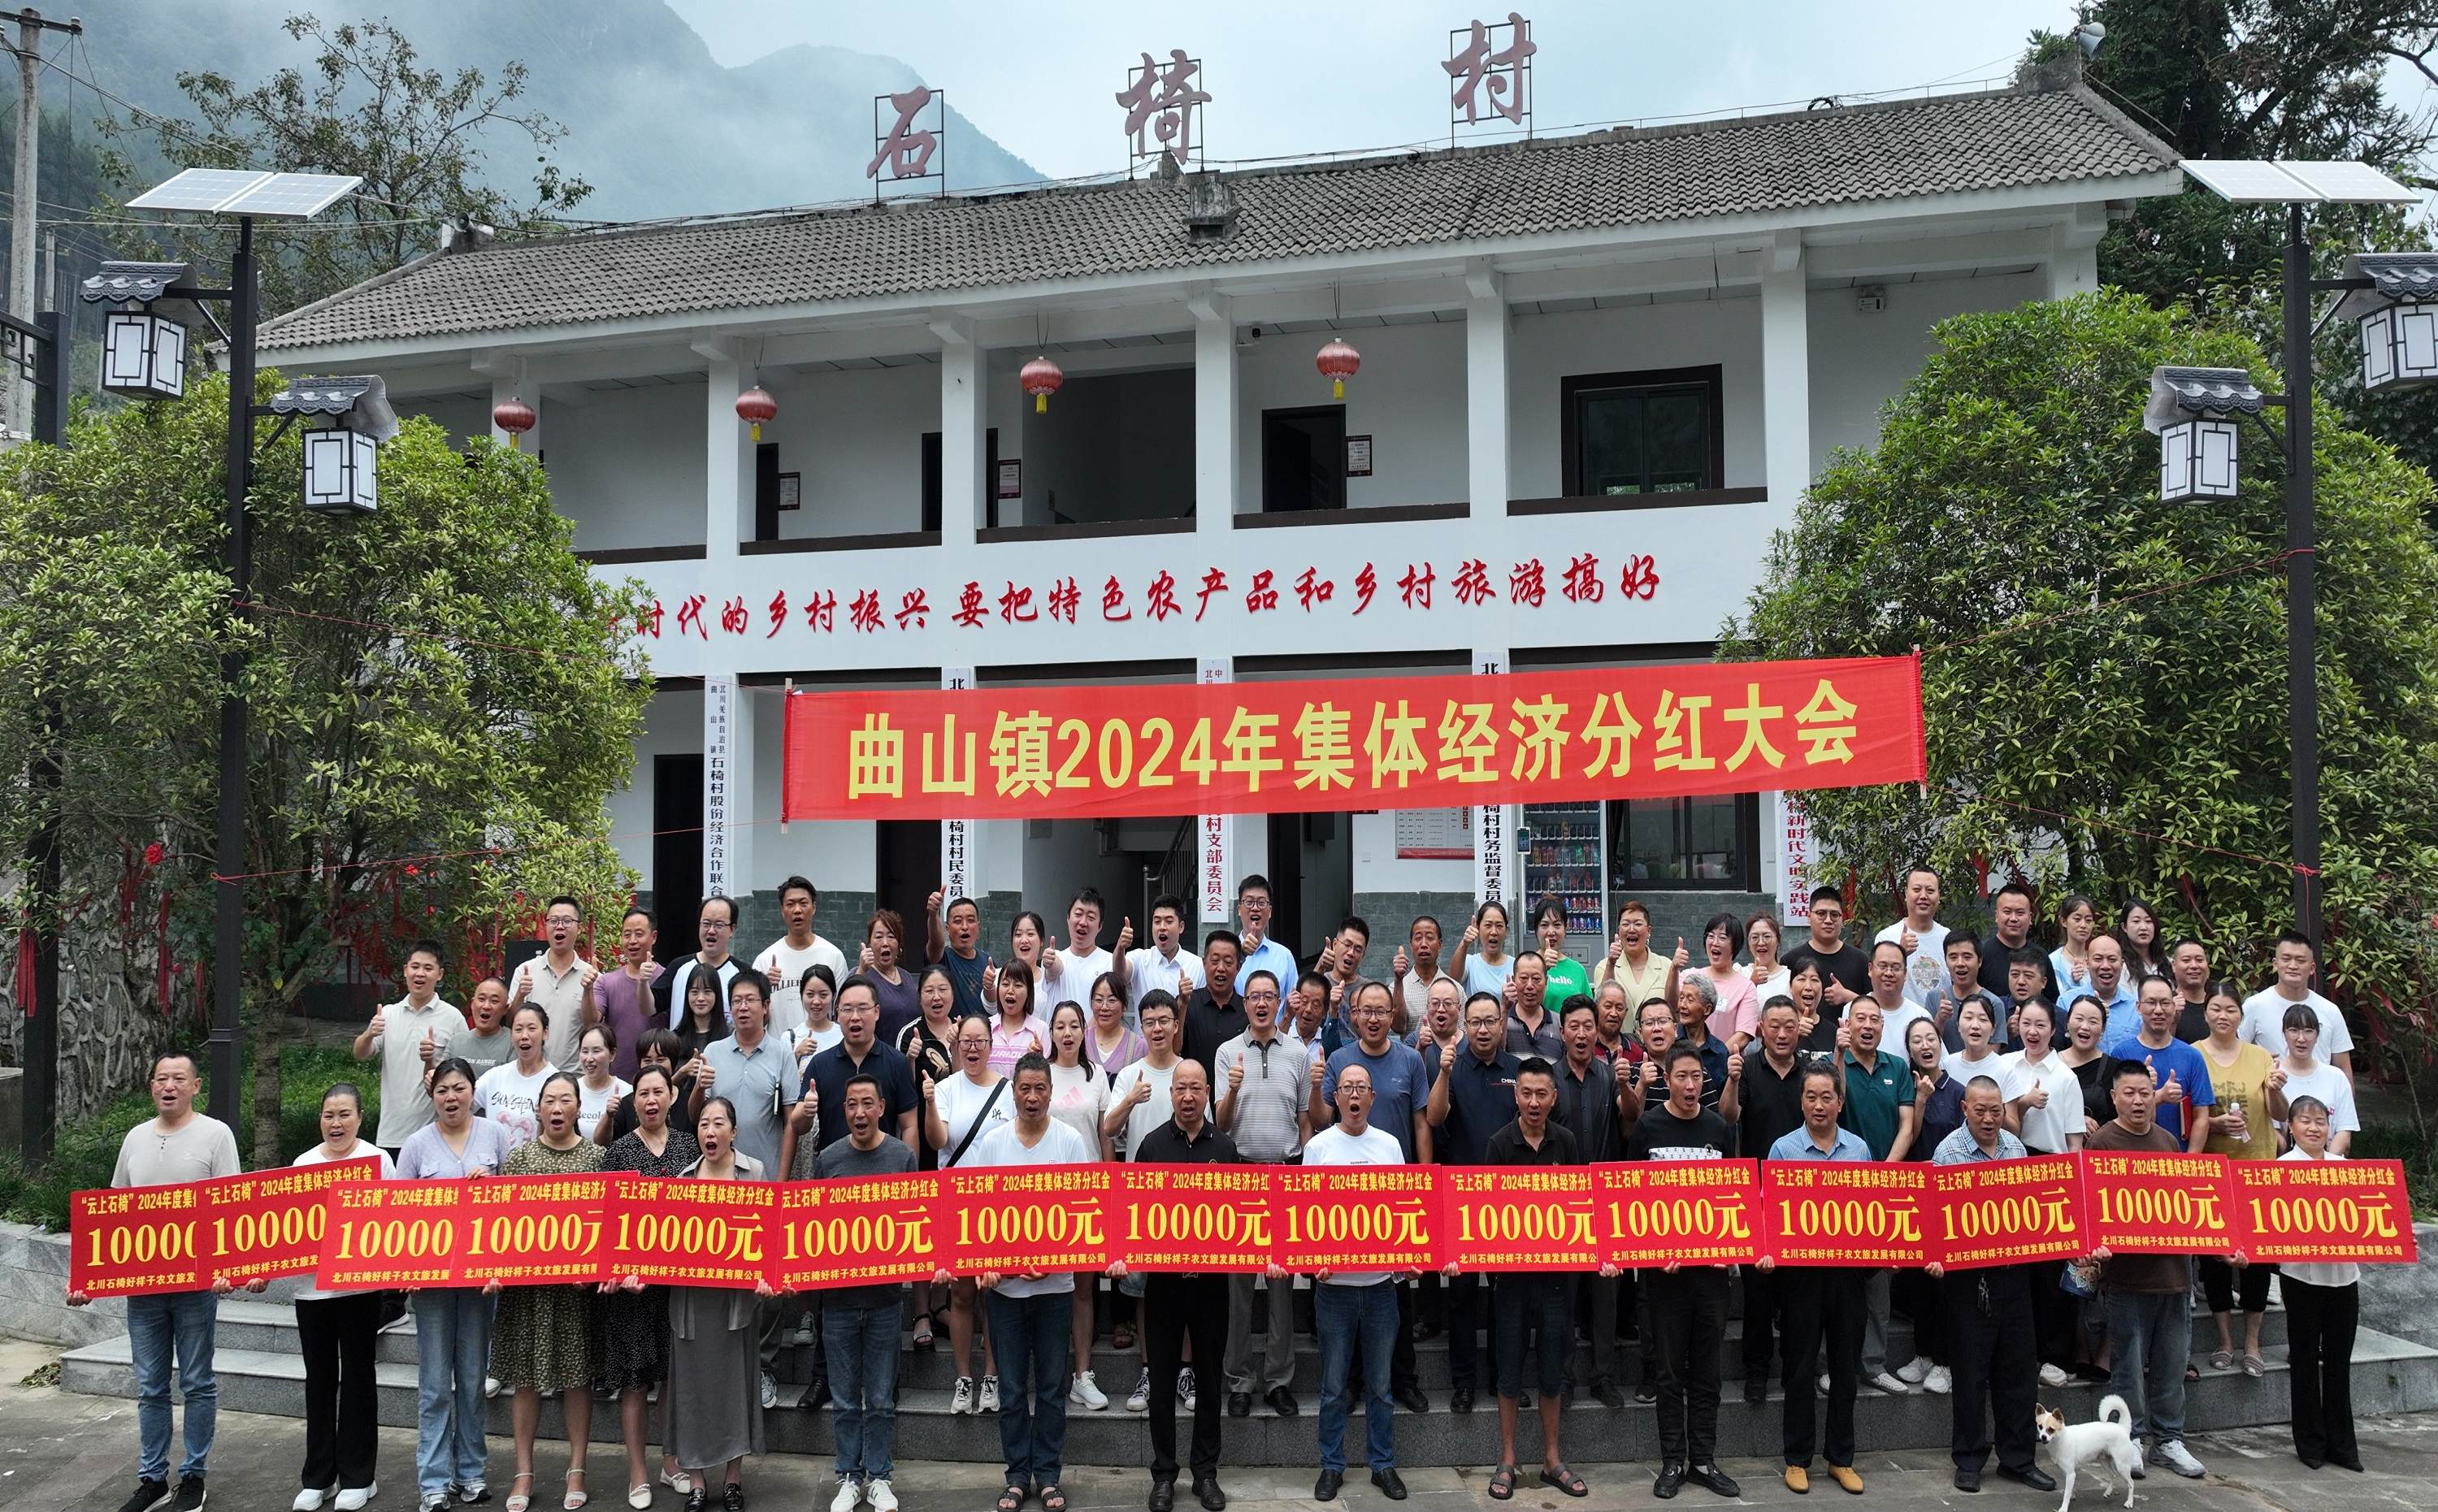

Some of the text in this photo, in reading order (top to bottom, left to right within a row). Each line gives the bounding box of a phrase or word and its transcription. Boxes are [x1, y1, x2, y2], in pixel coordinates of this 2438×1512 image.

[849, 680, 1856, 799] 曲山镇2024年集体经济分红大会
[211, 1203, 327, 1256] 10000
[956, 1196, 1105, 1246] 10000元
[1126, 1198, 1272, 1247] 10000元
[1286, 1197, 1430, 1246] 10000元
[1458, 1197, 1598, 1246] 10000元
[1607, 1191, 1751, 1240] 10000元
[1779, 1194, 1922, 1242] 10000元
[1941, 1186, 2076, 1241] 10000元
[2097, 1183, 2226, 1230] 10000元
[2249, 1191, 2399, 1239] 10000元
[335, 1219, 453, 1259] 10000
[614, 1212, 764, 1262] 10000元
[782, 1204, 934, 1260] 10000元
[1612, 1246, 1755, 1262] 北川石椅好样子农文旅发展有限公司
[1781, 1248, 1924, 1260] 北川石椅好样子农文旅发展有限公司
[1946, 1239, 2080, 1263] 北川石椅好样子农文旅发展有限公司
[2101, 1235, 2230, 1248] 北川石椅好样子农文旅发展有限公司
[2255, 1244, 2403, 1256] 北川石椅好样子农文旅发展有限公司
[85, 1272, 196, 1291] 北川石椅好样子农文旅发
[332, 1268, 451, 1284] 北川石椅好样子农文旅发展
[611, 1263, 763, 1284] 北川石椅好样子农文旅发展有限公司
[782, 1261, 935, 1285] 北川石椅好样子农文旅发展有限公司
[955, 1252, 1106, 1269] 北川石椅好样子农文旅发展有限公司
[1286, 1252, 1431, 1267] 北川石椅好样子农文旅发展有限公司
